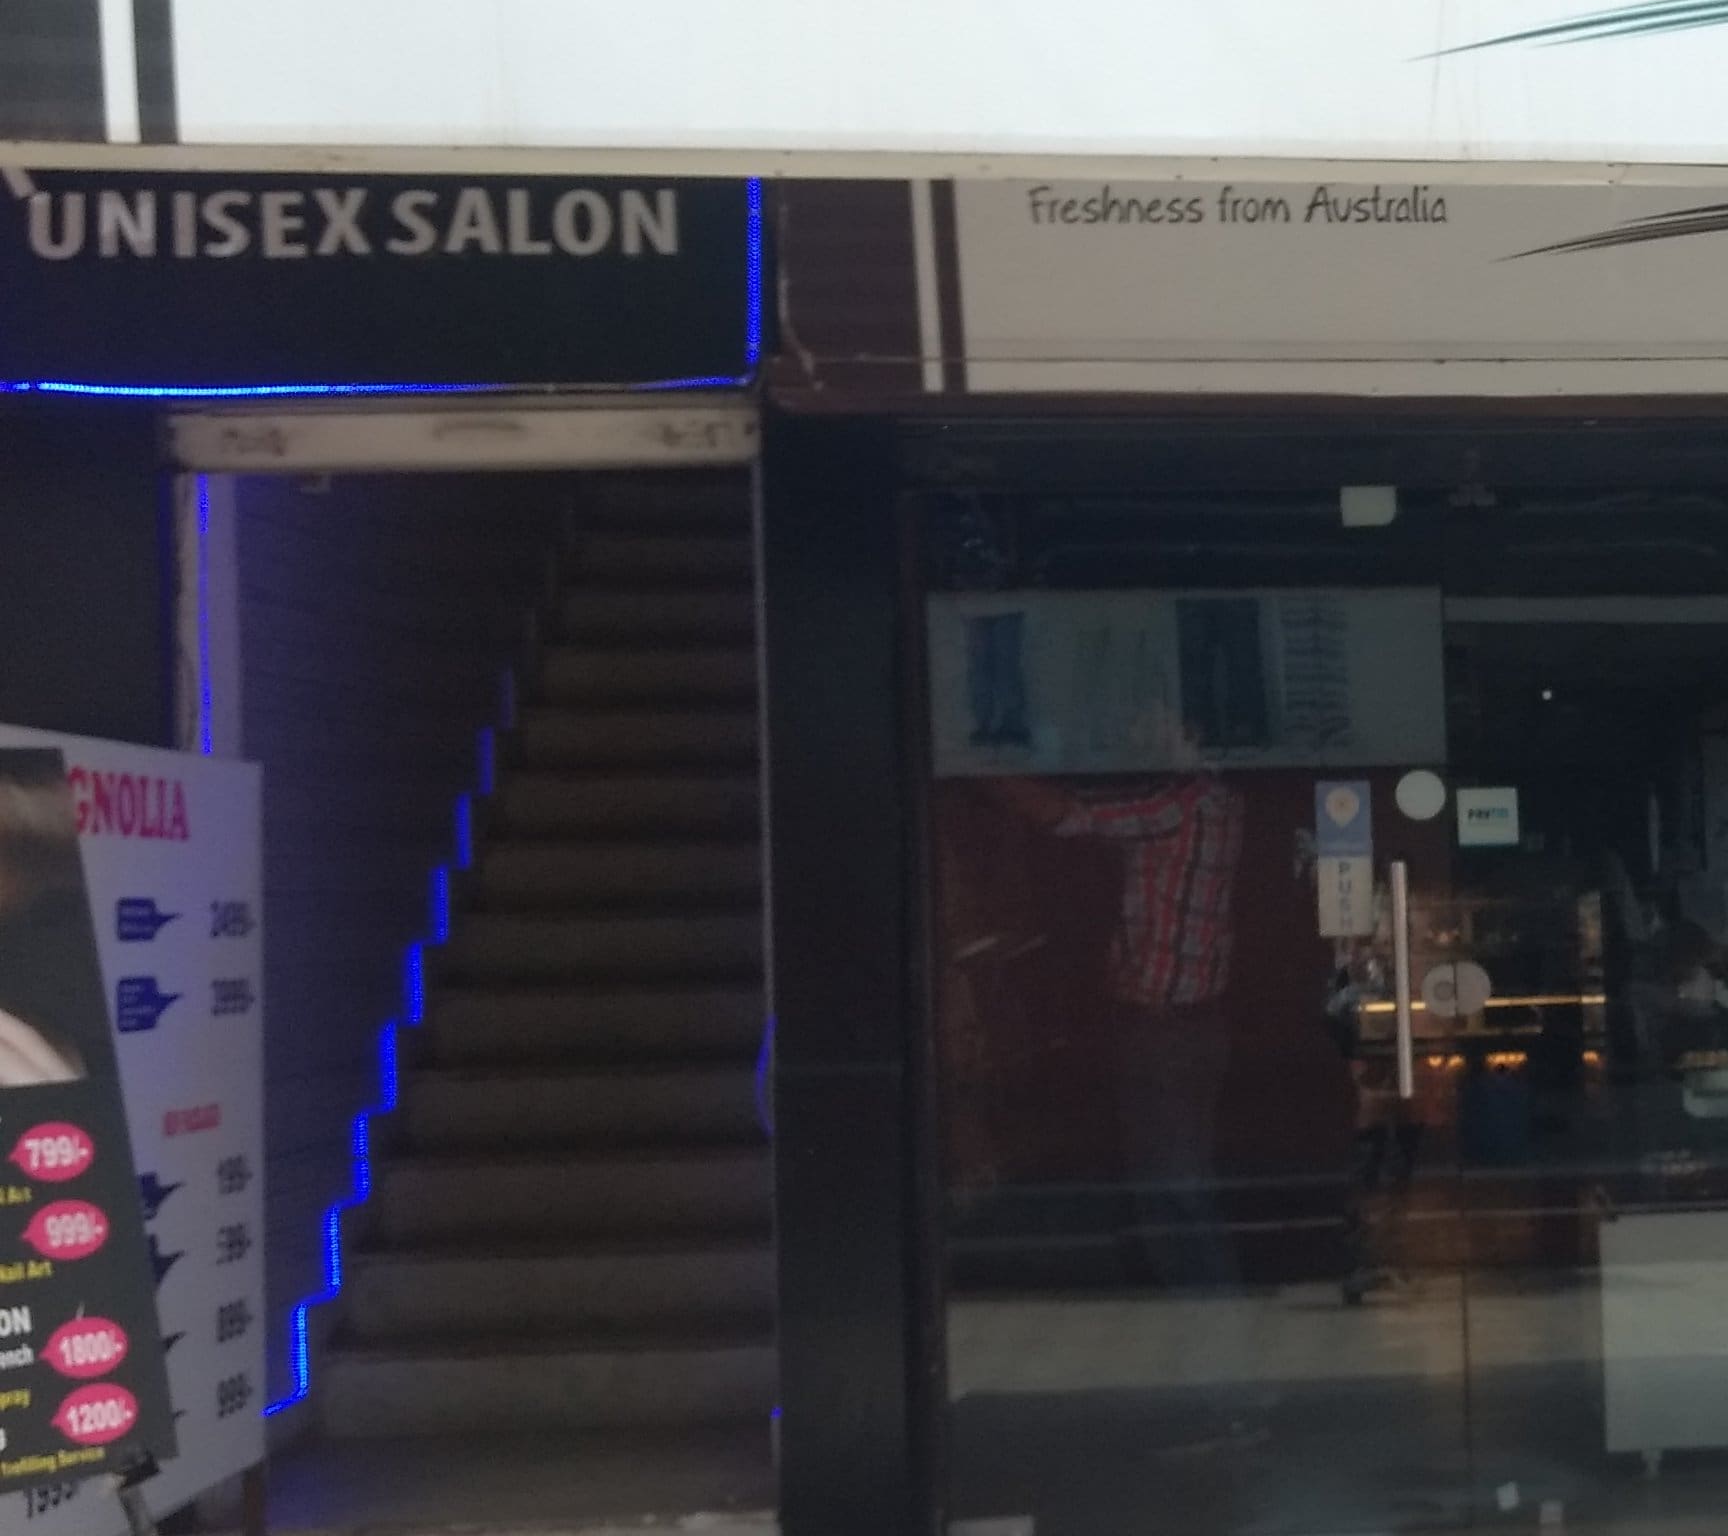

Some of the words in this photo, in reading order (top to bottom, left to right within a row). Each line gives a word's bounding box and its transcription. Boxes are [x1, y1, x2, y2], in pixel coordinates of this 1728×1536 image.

[28, 188, 372, 260] UNISEX
[385, 187, 679, 257] SALON
[1027, 185, 1204, 224] Freshness
[1217, 185, 1292, 224] from
[1304, 184, 1448, 224] Australia
